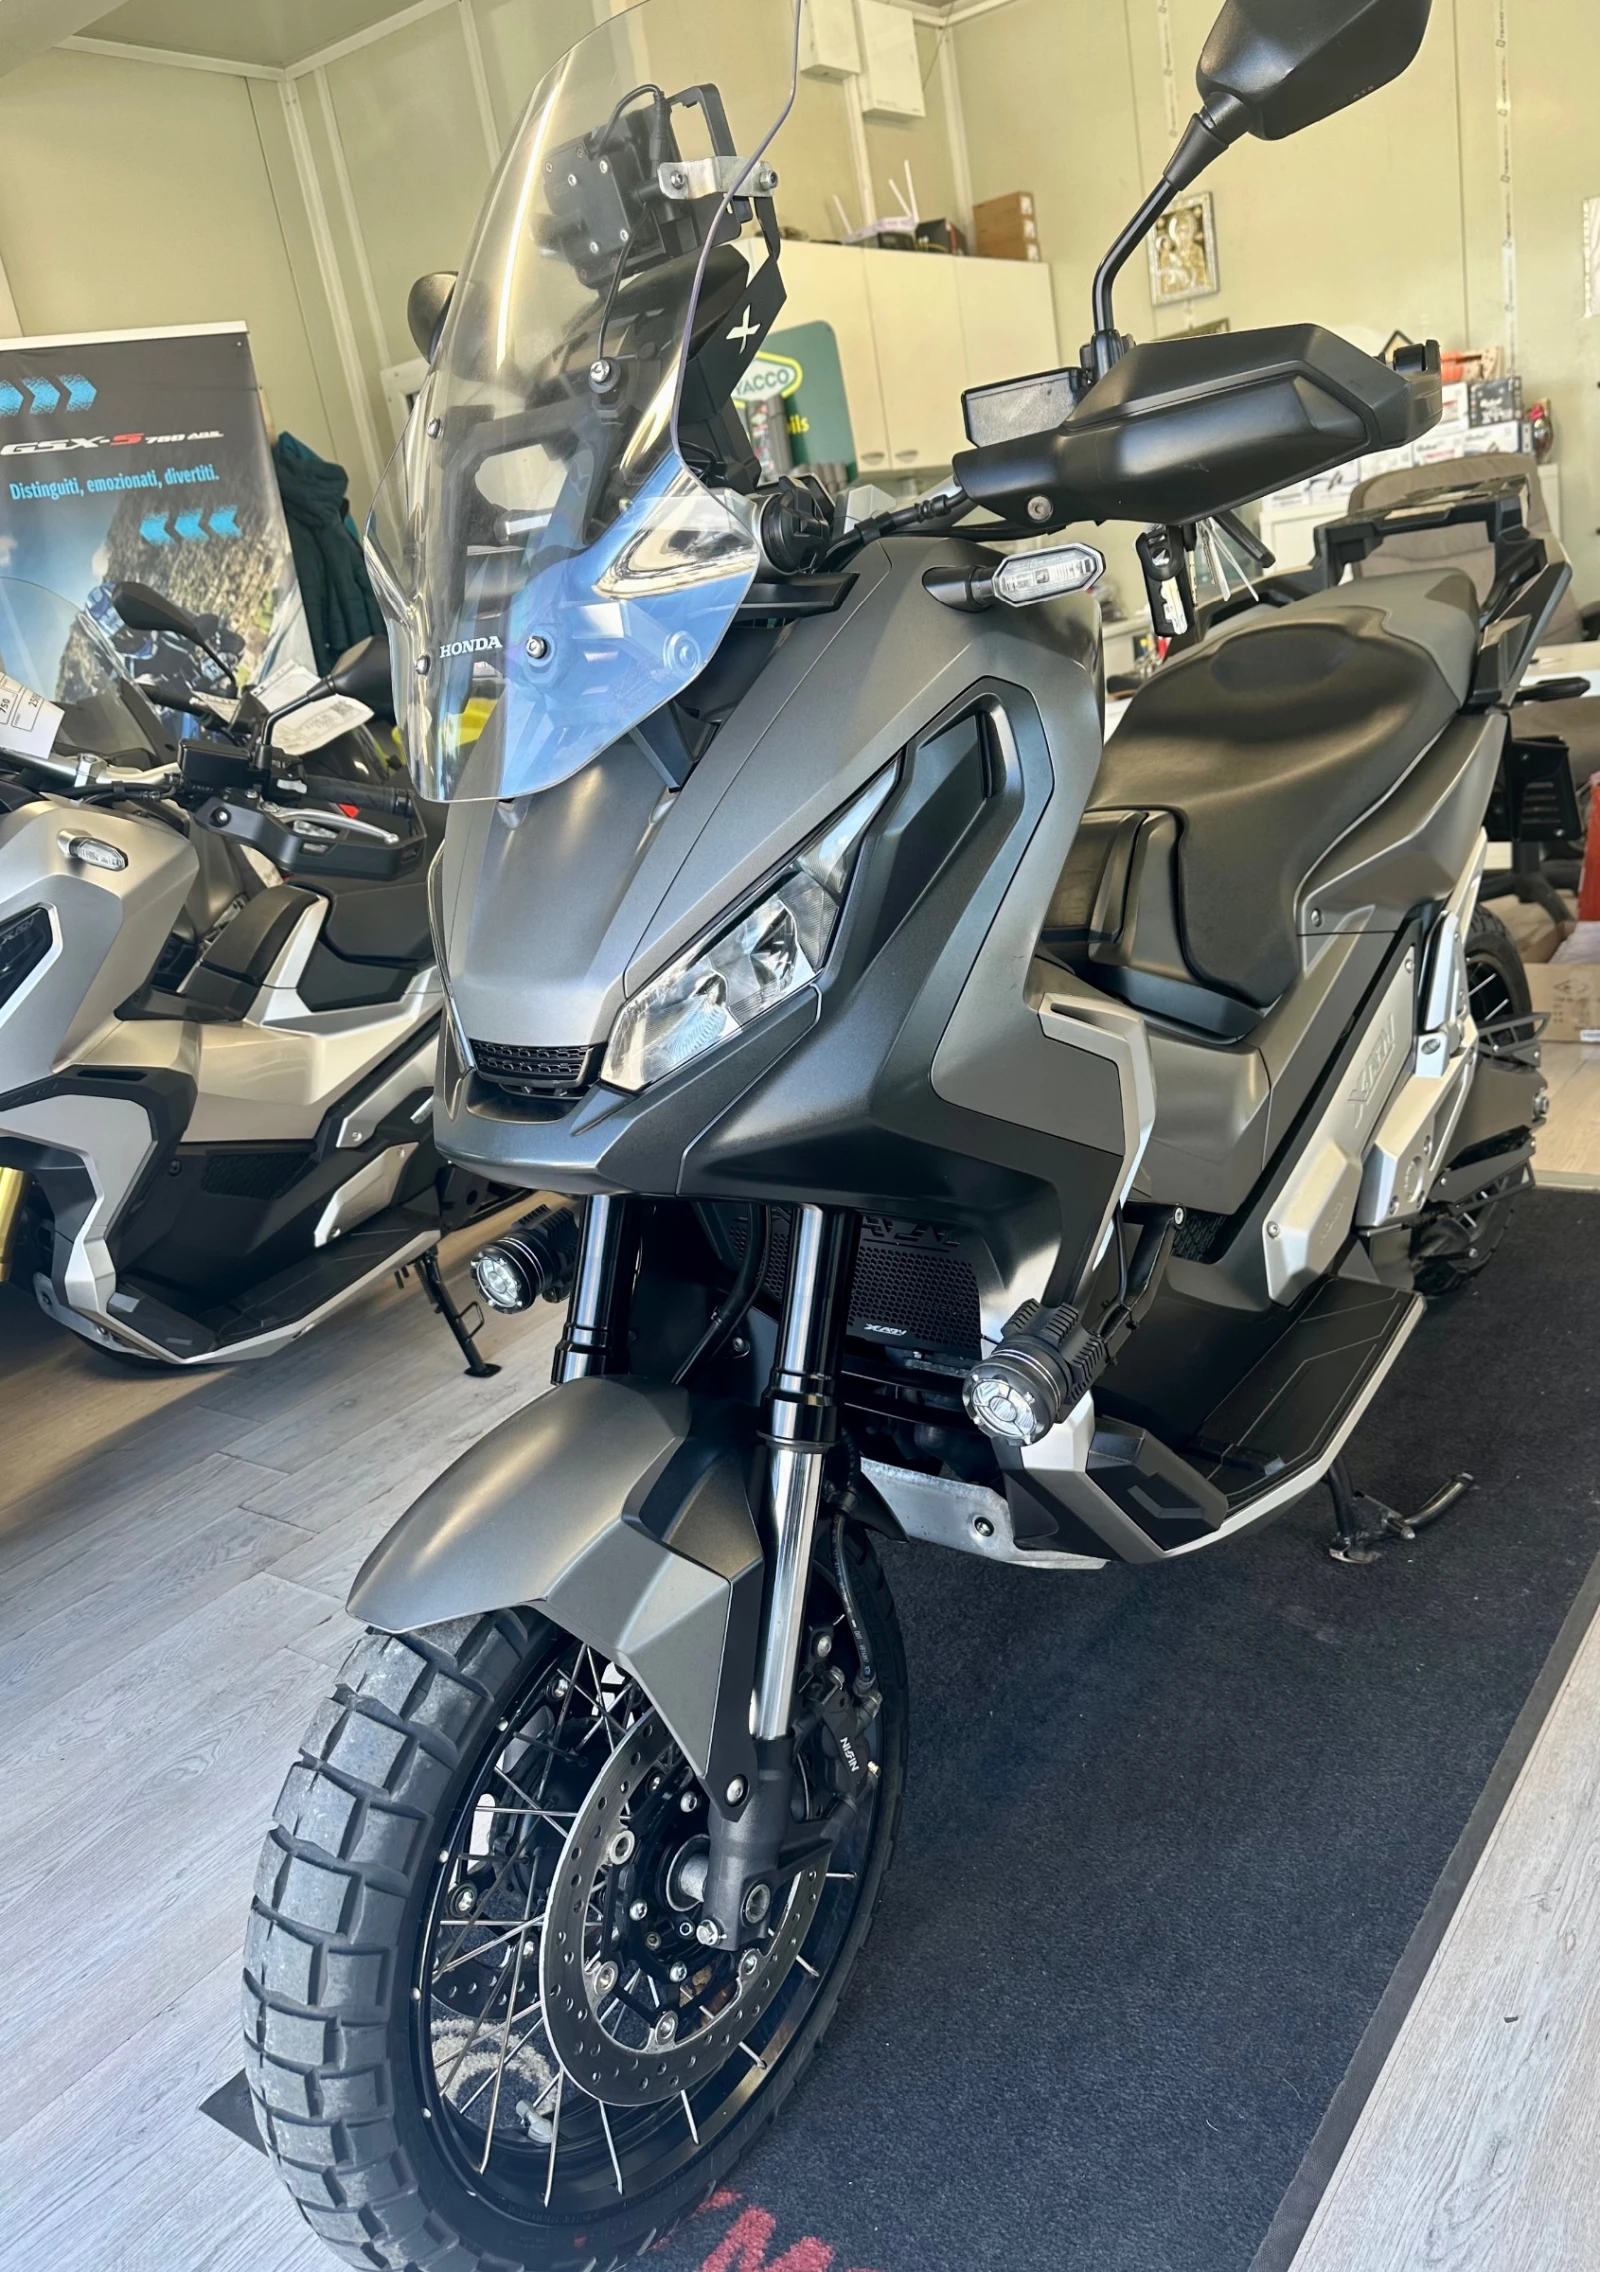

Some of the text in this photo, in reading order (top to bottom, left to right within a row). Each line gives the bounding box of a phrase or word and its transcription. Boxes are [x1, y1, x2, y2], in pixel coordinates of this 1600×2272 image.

[736, 369, 789, 395] YACCO
[0, 432, 144, 456] GSX-S
[145, 433, 186, 445] 750
[9, 463, 220, 500] Distinguiti, emozionati, divertiti.
[439, 635, 503, 659] HONDA
[840, 1736, 859, 1772] NISSIN
